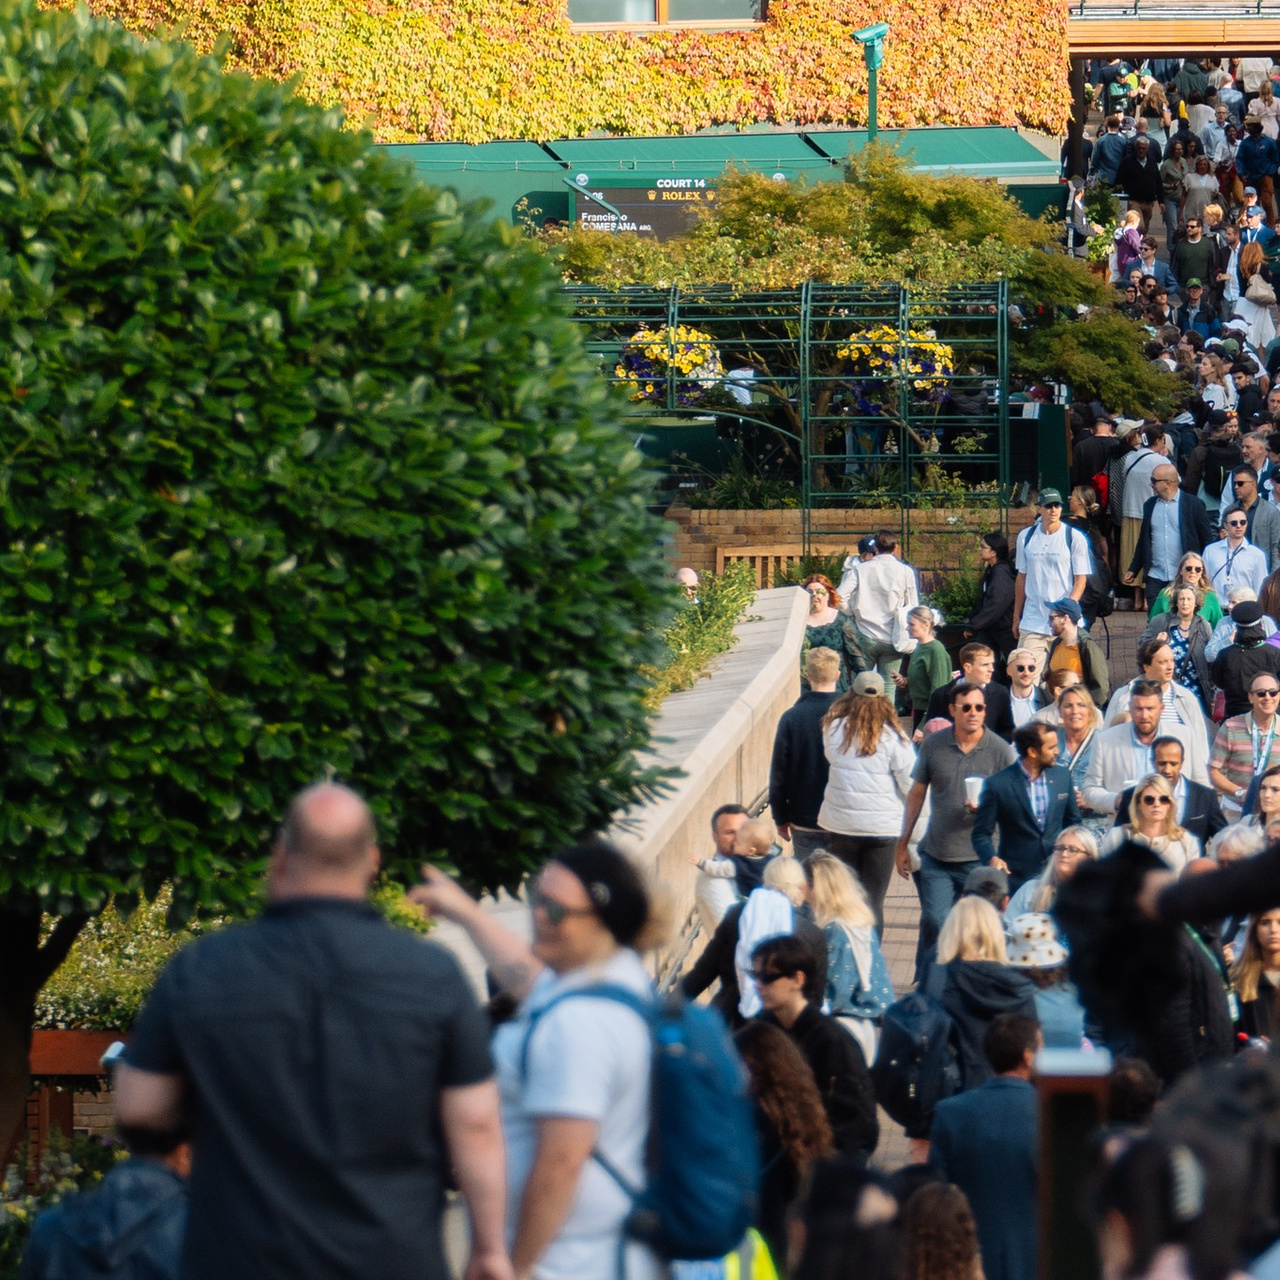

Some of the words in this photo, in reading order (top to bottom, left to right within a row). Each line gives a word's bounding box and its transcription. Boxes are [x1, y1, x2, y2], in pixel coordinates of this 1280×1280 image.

[656, 179, 692, 188] COURT
[694, 179, 705, 188] 14
[662, 191, 701, 200] ROLEX
